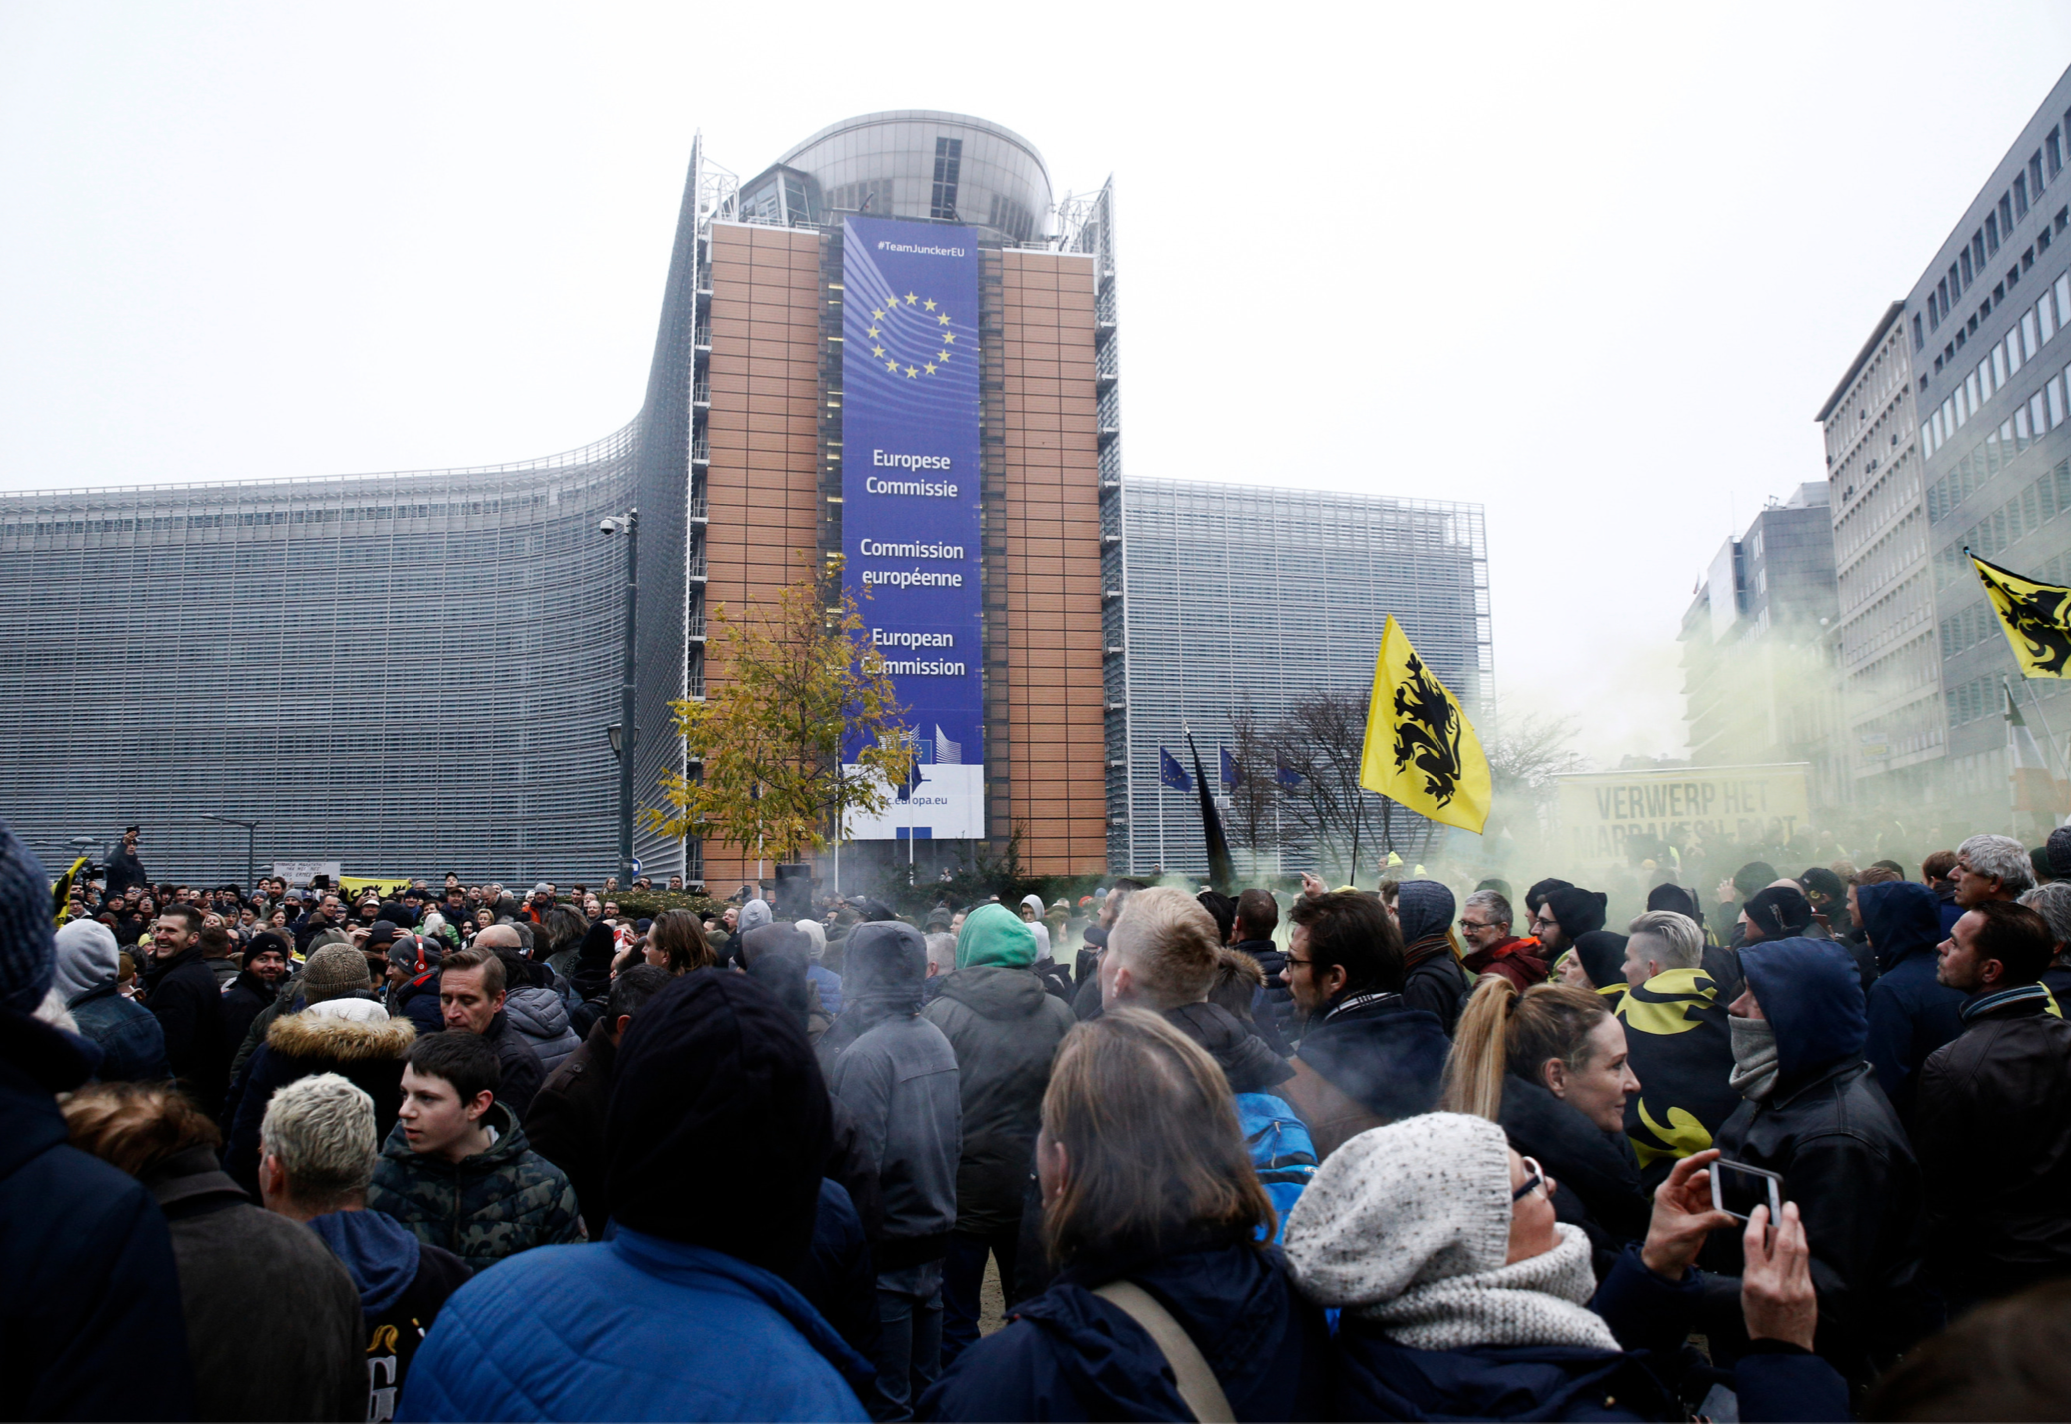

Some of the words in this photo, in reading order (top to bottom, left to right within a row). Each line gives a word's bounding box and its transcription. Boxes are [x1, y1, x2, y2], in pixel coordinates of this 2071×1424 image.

[878, 241, 965, 257] #TeamJunckerEU
[873, 449, 951, 472] Europese
[866, 477, 958, 497] Commissie
[860, 538, 964, 559] Commission
[862, 567, 962, 589] européenne
[872, 628, 953, 650] European
[886, 797, 948, 807] c.europa.eu
[1595, 782, 1716, 820] VERWERP
[1722, 780, 1769, 814] HET
